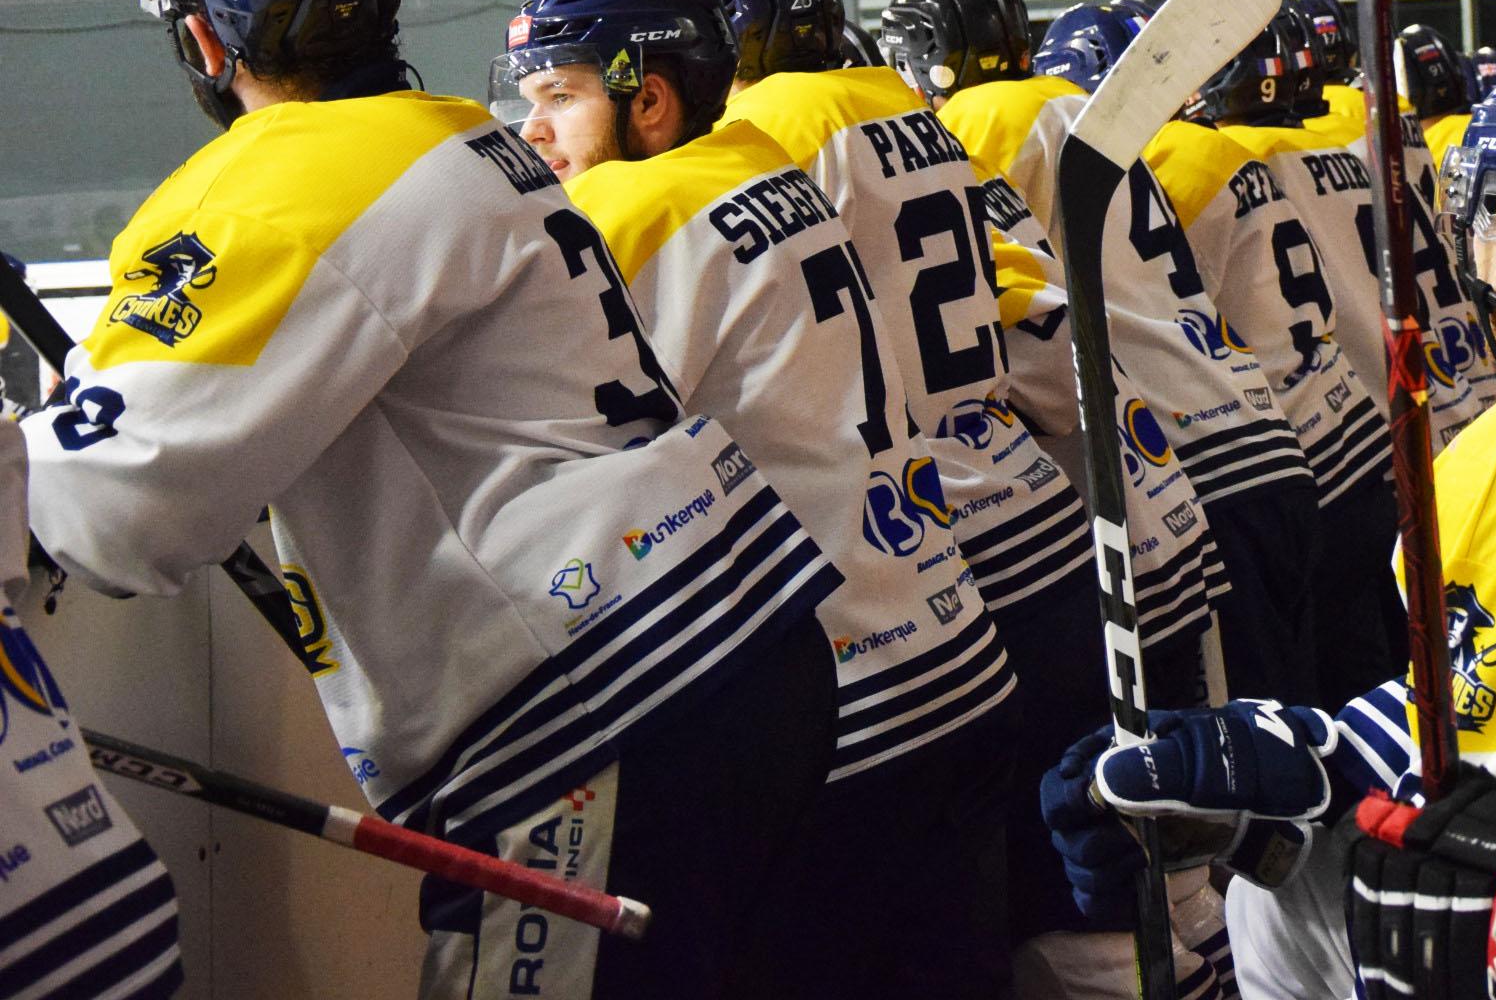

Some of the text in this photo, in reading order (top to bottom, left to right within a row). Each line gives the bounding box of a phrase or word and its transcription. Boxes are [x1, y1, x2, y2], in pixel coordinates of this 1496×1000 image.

[630, 28, 682, 43] CCM
[885, 34, 904, 45] CCM
[1260, 78, 1276, 103] 9
[1138, 745, 1160, 790] CCM
